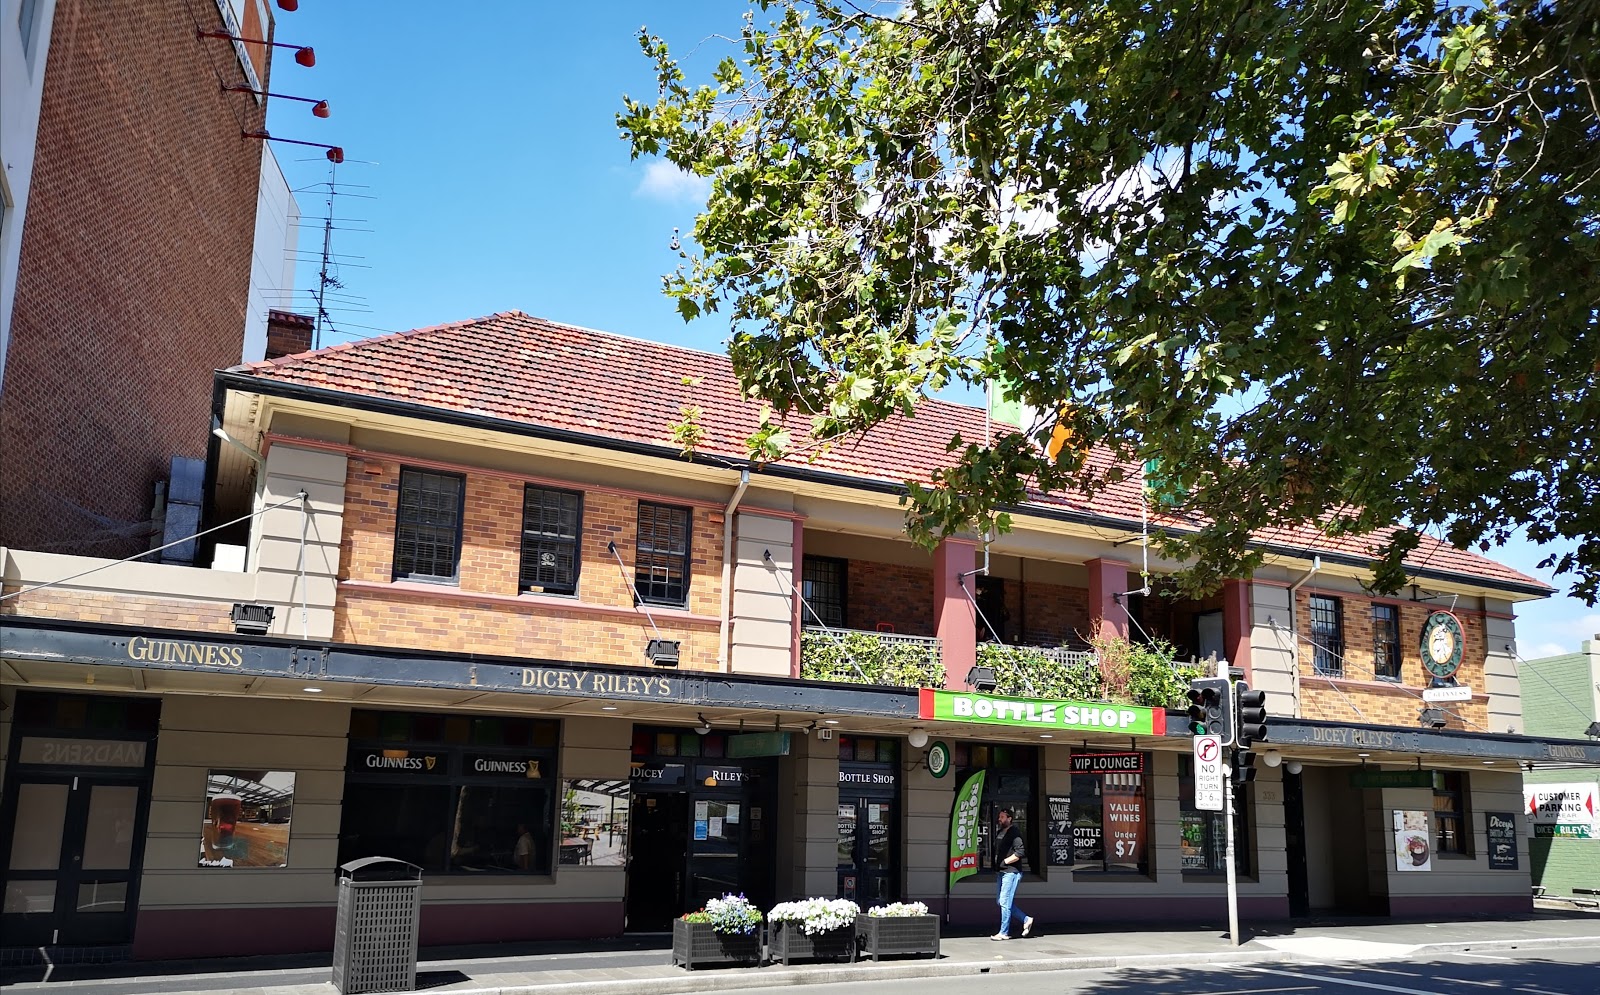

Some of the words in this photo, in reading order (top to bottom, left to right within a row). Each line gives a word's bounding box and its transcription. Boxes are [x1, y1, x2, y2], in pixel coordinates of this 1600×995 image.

[128, 636, 243, 666] GUINNESS
[521, 668, 588, 690] DICEY
[592, 674, 671, 696] RILEY'S
[953, 697, 1056, 722] BOTTLE
[1064, 706, 1136, 728] SHOP
[1313, 728, 1346, 742] DICEY
[1351, 730, 1393, 745] RILEY'S
[1549, 746, 1585, 758] GUINNESS
[366, 754, 422, 769] GUINNESS
[474, 758, 526, 773] GUINNESS
[1075, 758, 1091, 769] VIP
[1093, 757, 1138, 769] LOUNGE
[632, 767, 664, 778] DICEY
[1201, 764, 1215, 773] NO
[712, 770, 750, 782] RILEY'S
[839, 772, 870, 783] BOTTLE
[873, 774, 895, 784] SHOP
[1538, 793, 1581, 801] CUSTOMER
[1049, 803, 1070, 813] VALUE
[1110, 803, 1140, 812] VALUE
[1539, 803, 1582, 812] PARKING
[1051, 812, 1069, 820] WINE
[1110, 814, 1140, 822] WINES
[957, 801, 969, 850] SHOP
[1073, 828, 1101, 837] OTTLE
[1114, 831, 1137, 839] Under
[1073, 838, 1096, 847] SHOP
